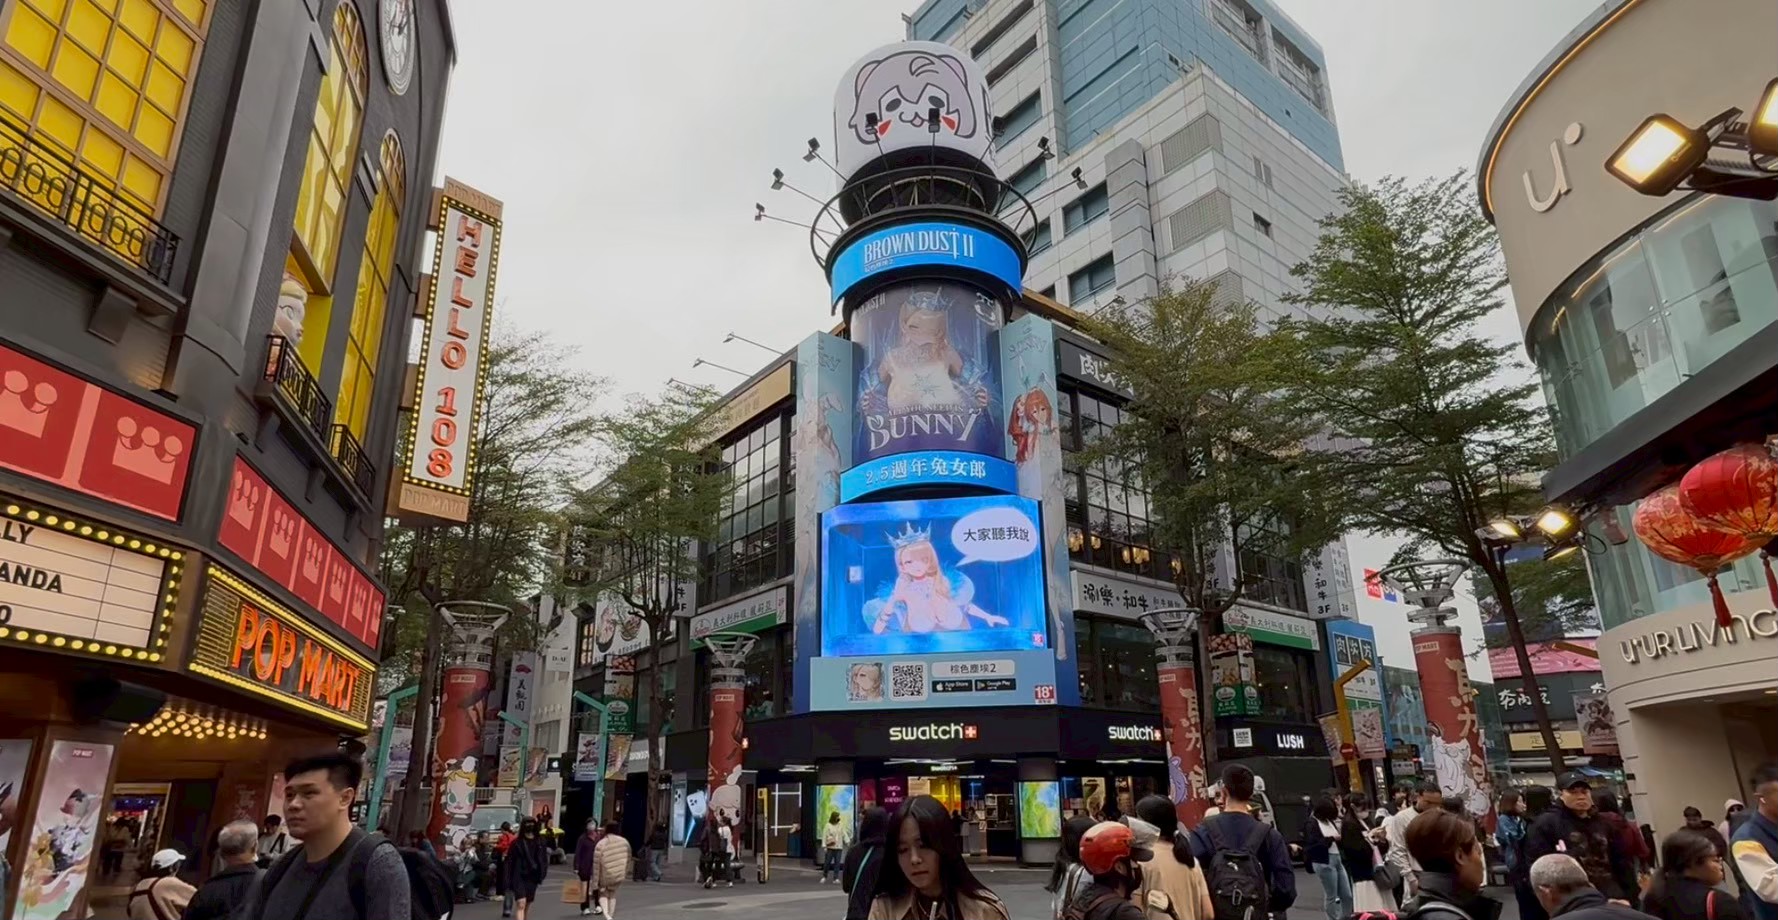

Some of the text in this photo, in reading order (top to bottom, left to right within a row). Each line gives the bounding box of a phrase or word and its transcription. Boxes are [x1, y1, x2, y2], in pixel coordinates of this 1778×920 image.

[863, 227, 975, 264] BROWN DUST II
[427, 215, 484, 478] HELLO 108
[866, 408, 982, 452] BUNNY
[865, 455, 987, 485] 2.5週年兔女郎
[963, 526, 1030, 543] 大家聽我說
[1317, 604, 1331, 614] 3F
[230, 602, 358, 712] POP MART
[889, 722, 964, 741] swatch
[1108, 725, 1154, 741] swatch
[1276, 733, 1305, 749] LUSH
